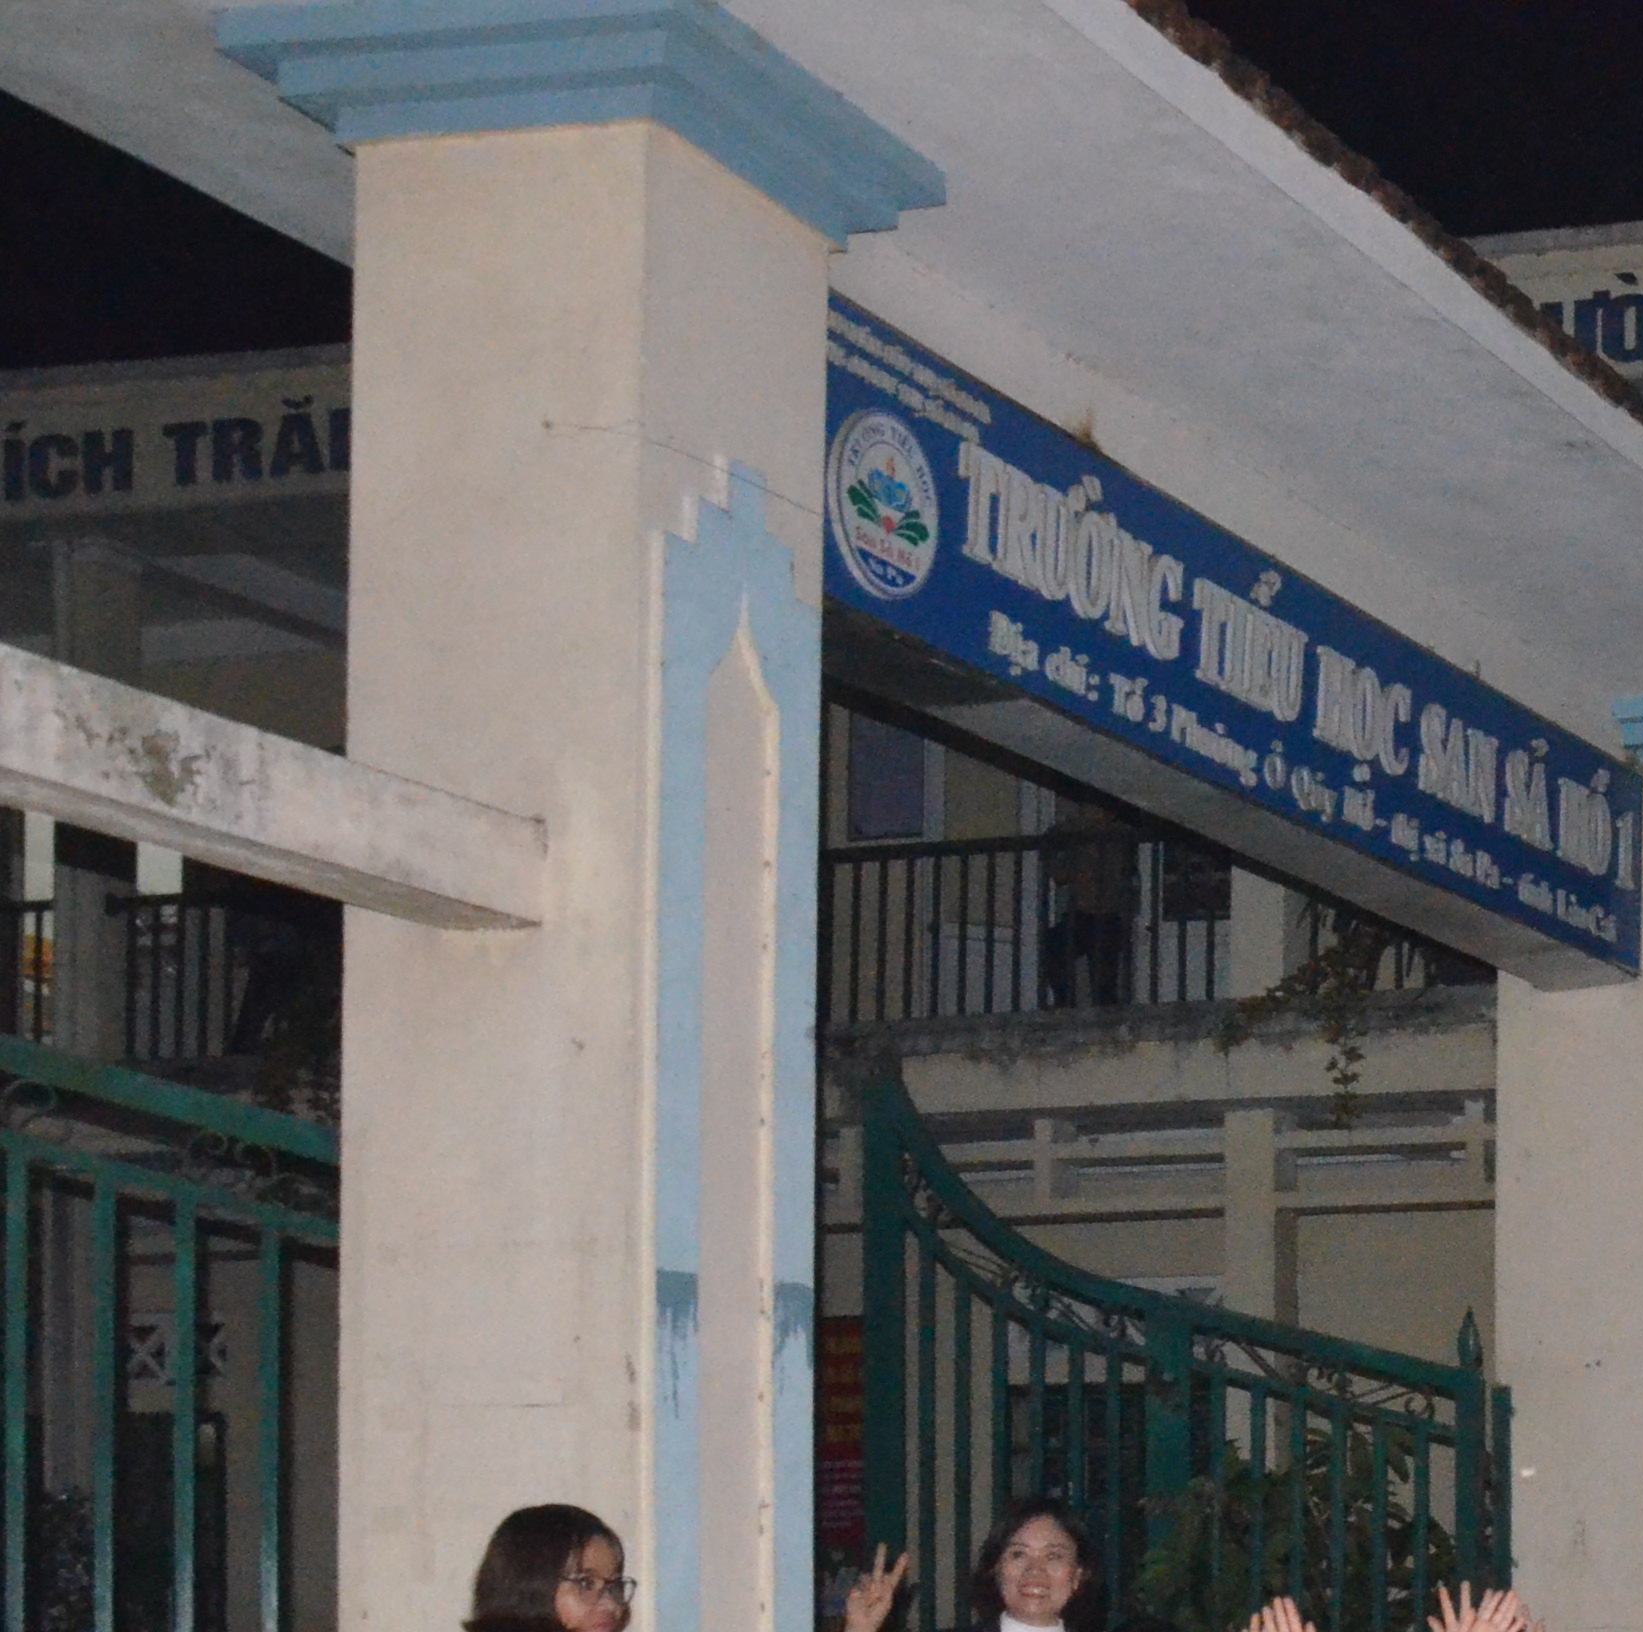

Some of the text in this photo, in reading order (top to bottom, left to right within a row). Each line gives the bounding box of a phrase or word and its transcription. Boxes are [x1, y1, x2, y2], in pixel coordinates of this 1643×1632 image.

[958, 441, 1185, 661] TRƯỜNG
[1193, 569, 1309, 722] TIỂU
[1311, 644, 1412, 782] HỌC
[1417, 703, 1499, 825] SAN
[1503, 737, 1554, 852] SẢ
[1614, 810, 1636, 891] 1
[1147, 694, 1168, 733] 3
